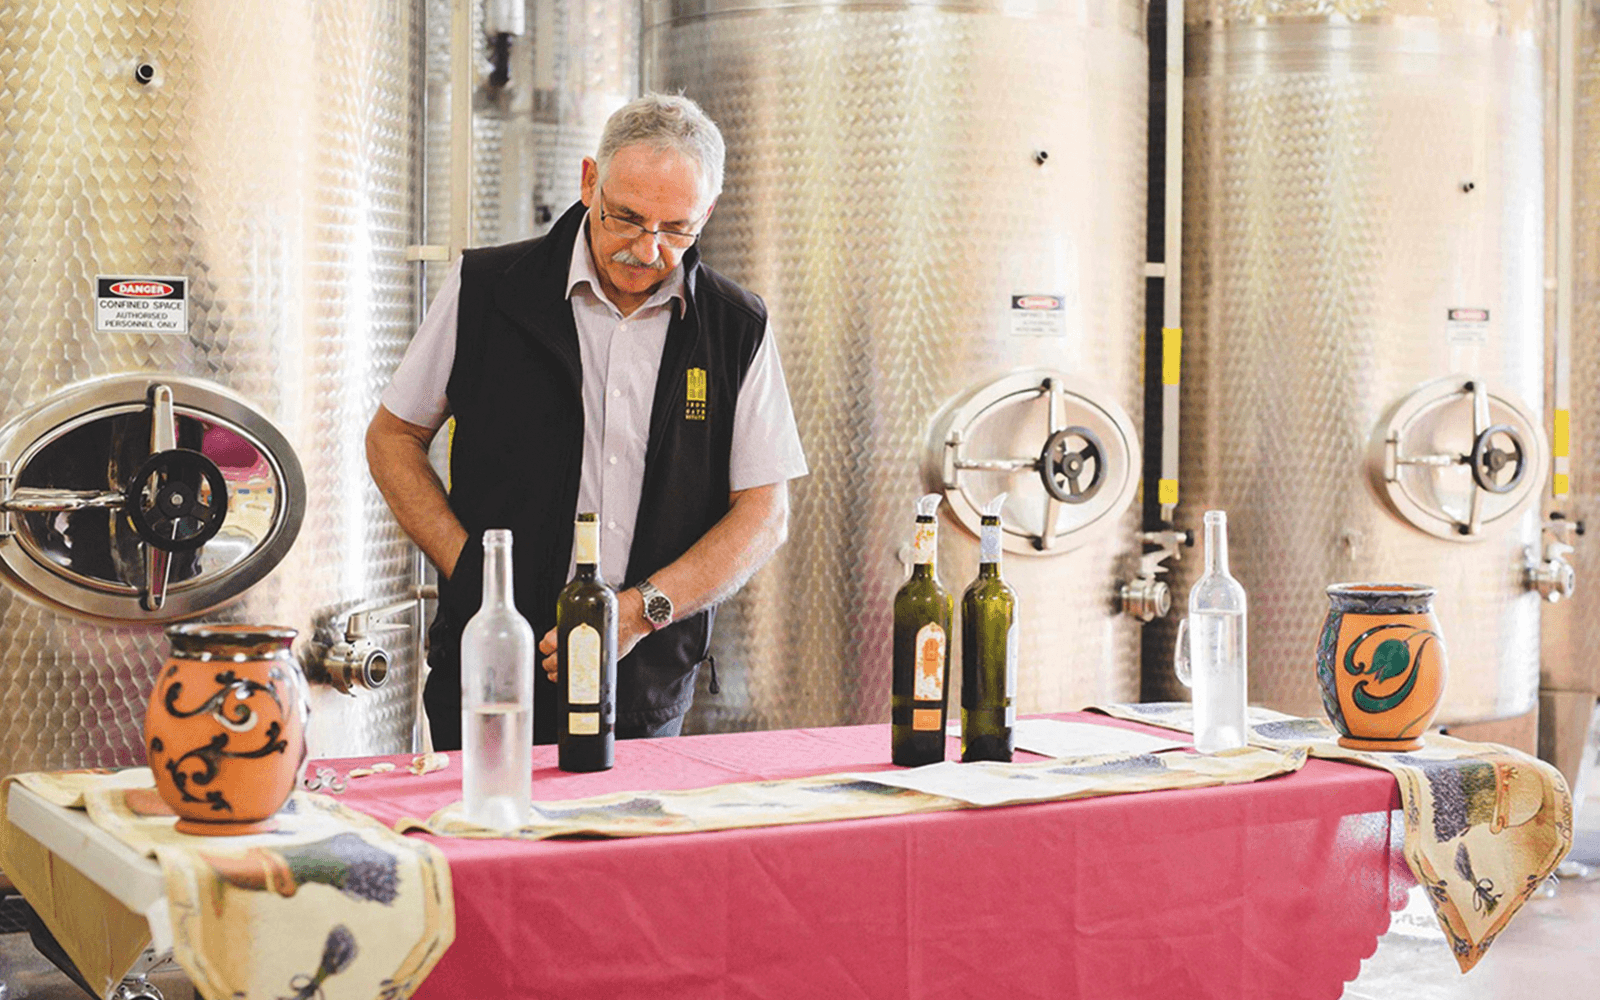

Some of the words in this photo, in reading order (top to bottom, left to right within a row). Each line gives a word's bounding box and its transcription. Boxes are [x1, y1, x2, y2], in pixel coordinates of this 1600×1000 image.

[119, 284, 164, 294] DANGER
[99, 300, 150, 309] CONFINED
[152, 301, 183, 310] SPACE
[105, 320, 153, 328] PERSONNEL
